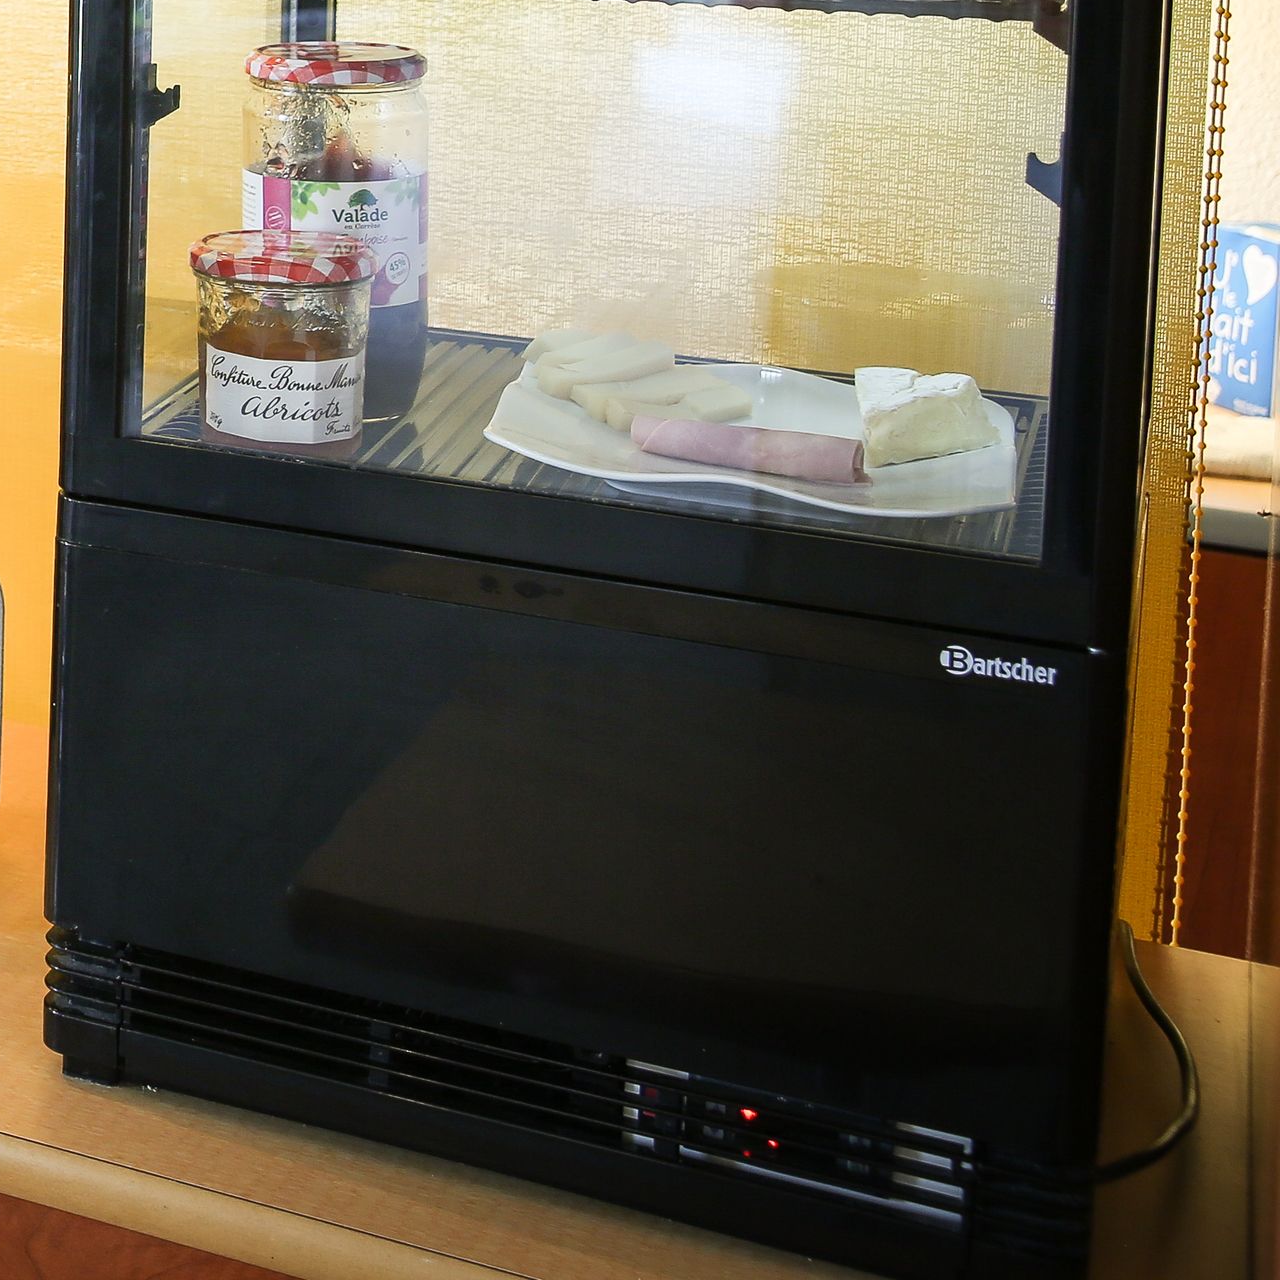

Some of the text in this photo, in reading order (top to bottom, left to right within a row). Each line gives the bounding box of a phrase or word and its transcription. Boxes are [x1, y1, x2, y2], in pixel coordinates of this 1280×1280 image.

[332, 208, 389, 223] Valade
[211, 354, 267, 390] Confiture
[268, 365, 323, 391] Bonne
[241, 395, 344, 422] Abricots
[939, 644, 1058, 685] Bartscher
